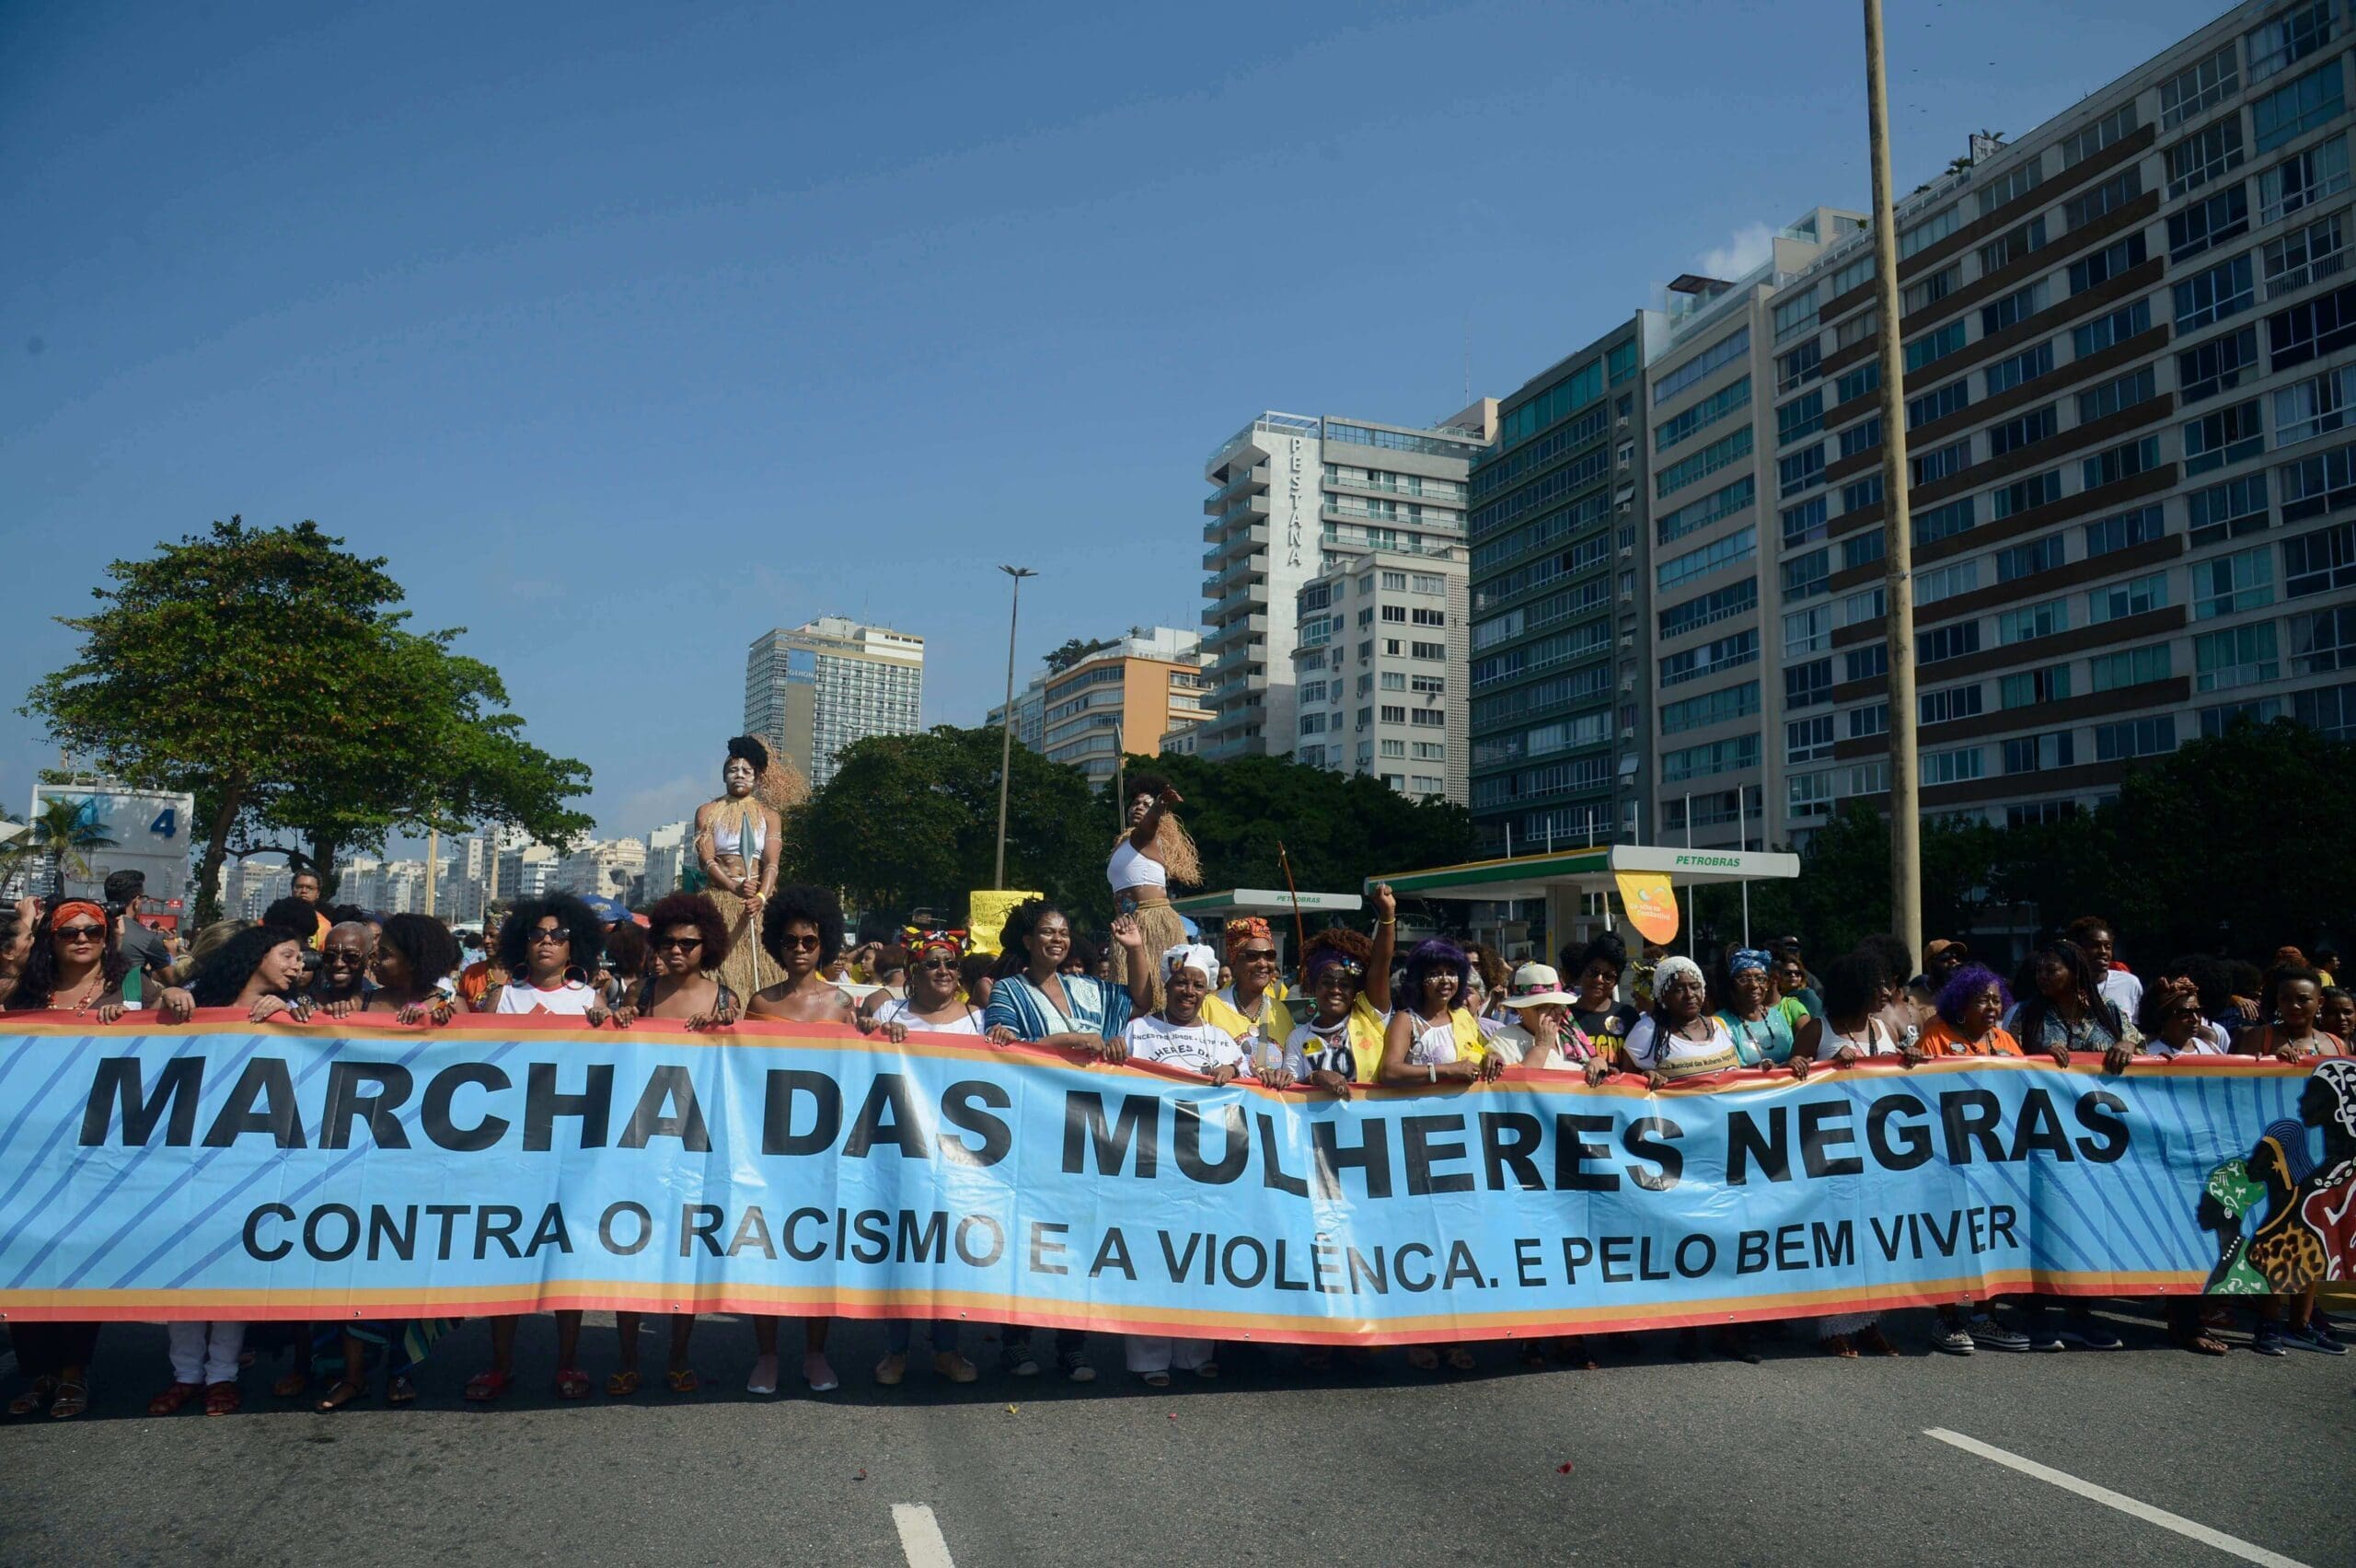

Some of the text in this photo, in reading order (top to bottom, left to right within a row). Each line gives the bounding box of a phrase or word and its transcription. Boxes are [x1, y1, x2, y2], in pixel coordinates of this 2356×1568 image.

[1288, 437, 1302, 567] PESTANA
[150, 808, 177, 838] 4
[1676, 855, 1741, 867] PETROBRAS
[80, 1055, 2131, 1200] MARCHA DAS MULHERES NEGRAS
[242, 1202, 573, 1262] CONTRA
[598, 1201, 652, 1255] O
[679, 1204, 1005, 1267] RACISMO
[1030, 1222, 1070, 1276] E
[1089, 1227, 1138, 1281] A
[1515, 1239, 1547, 1287] E
[1563, 1232, 1717, 1285] PELO
[1736, 1219, 1855, 1275] BEM
[1870, 1205, 2020, 1262] VIVER
